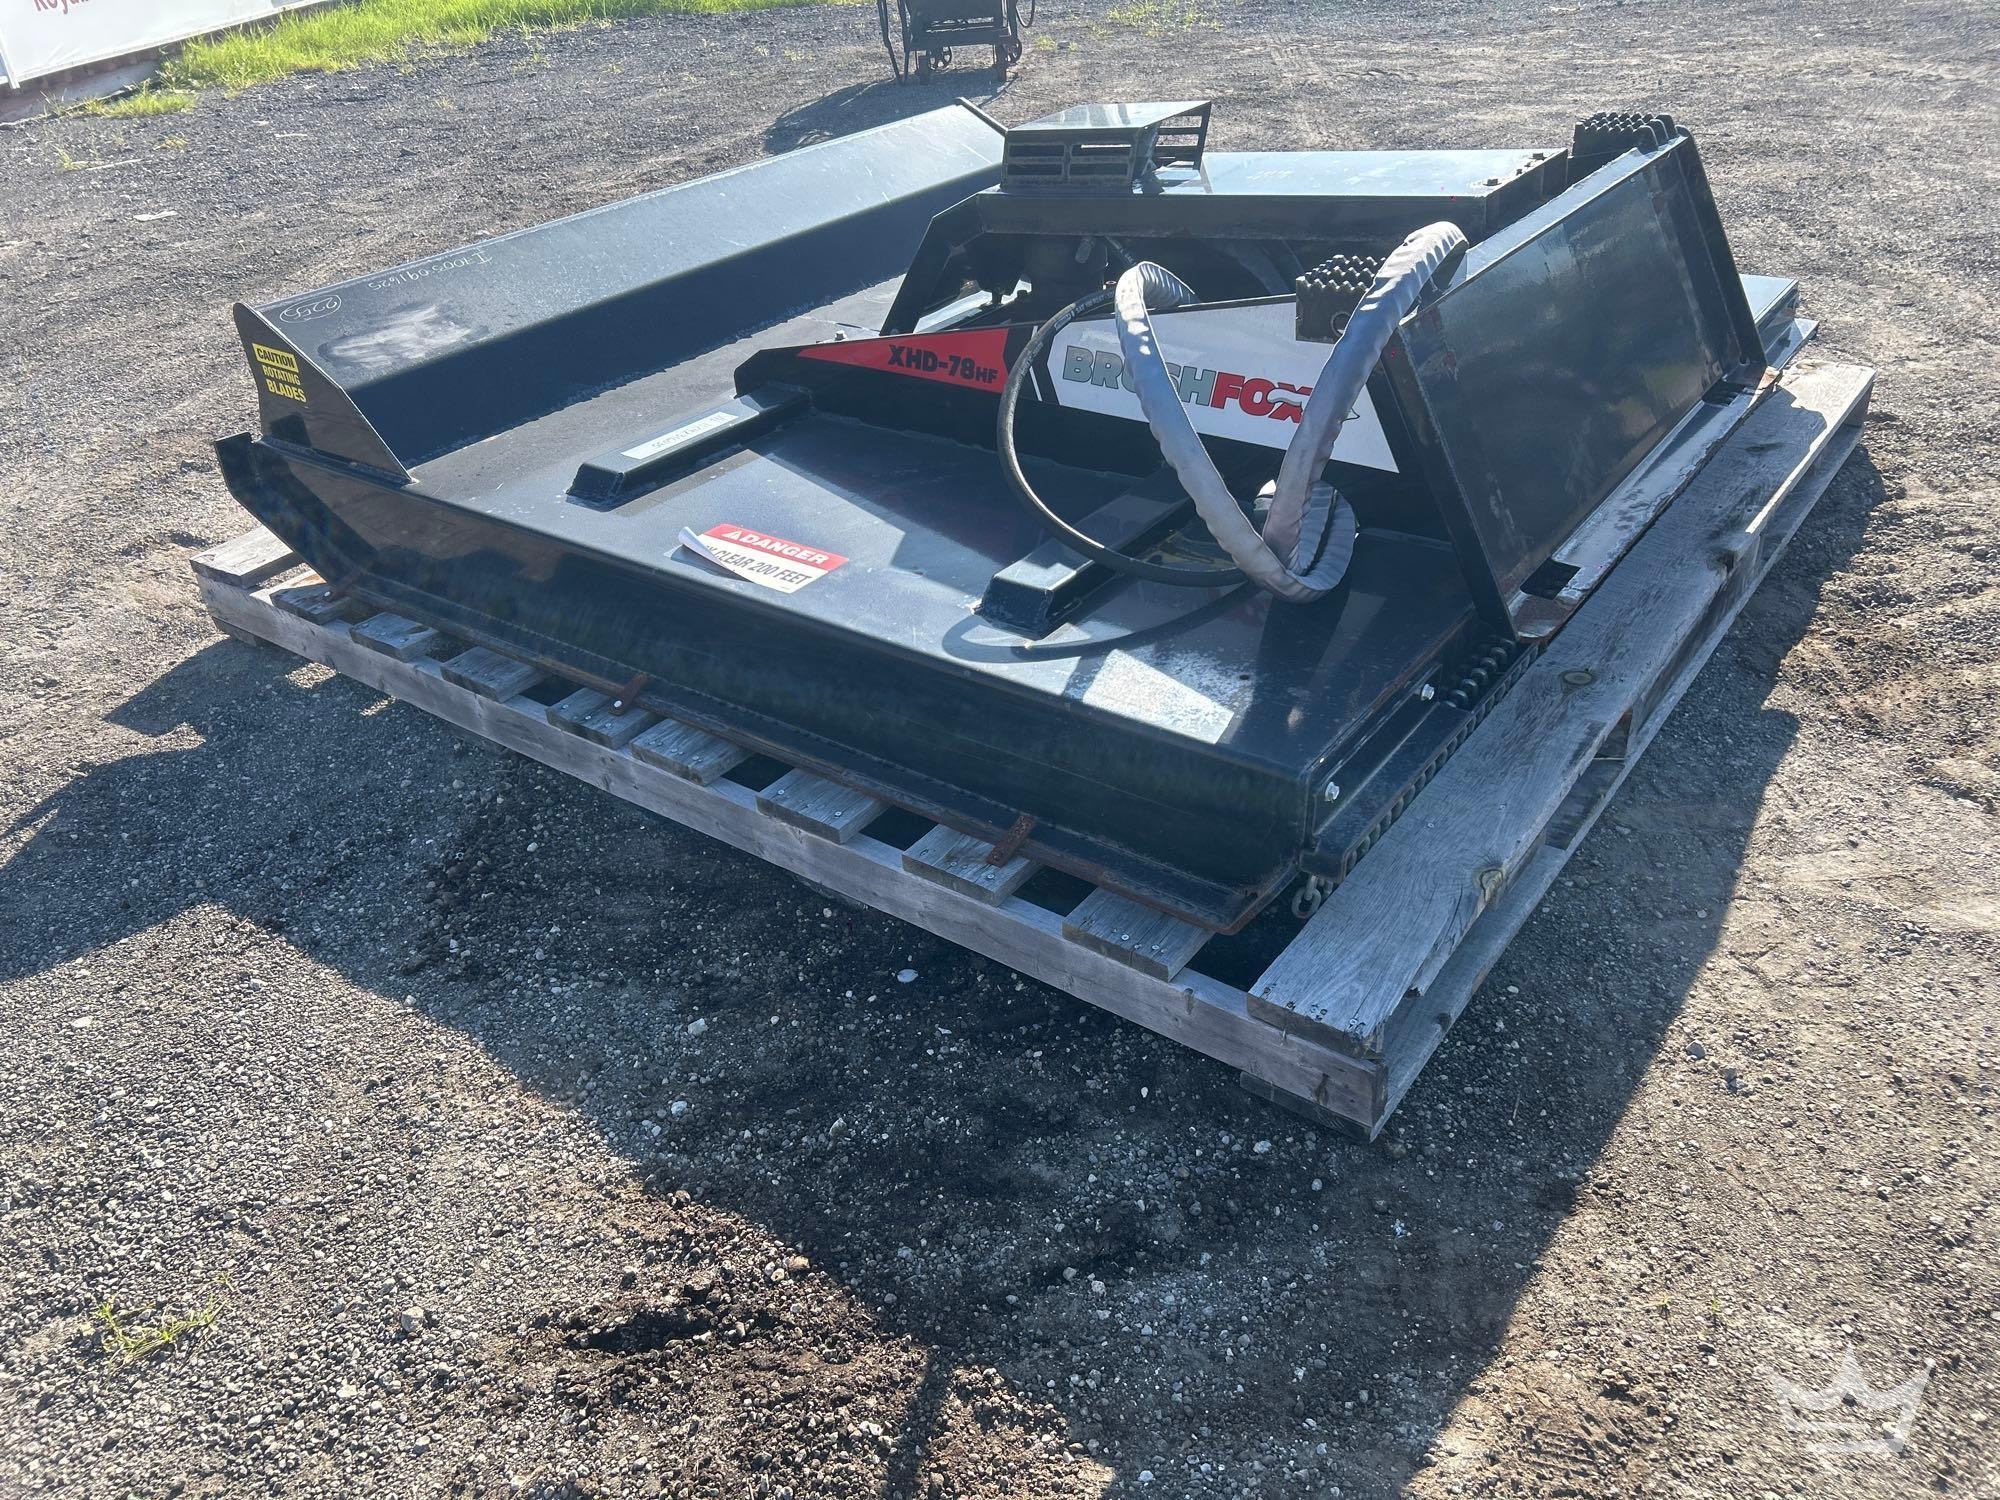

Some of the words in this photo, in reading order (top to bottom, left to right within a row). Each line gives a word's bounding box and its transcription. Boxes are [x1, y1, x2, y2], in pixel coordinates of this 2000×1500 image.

[256, 348, 296, 369] CAUTION
[261, 364, 301, 386] ROTATING
[265, 378, 307, 403] BLADES
[743, 535, 830, 565] DANGER
[716, 550, 755, 570] CLEAR
[749, 562, 778, 576] 200
[774, 570, 813, 585] FEET
